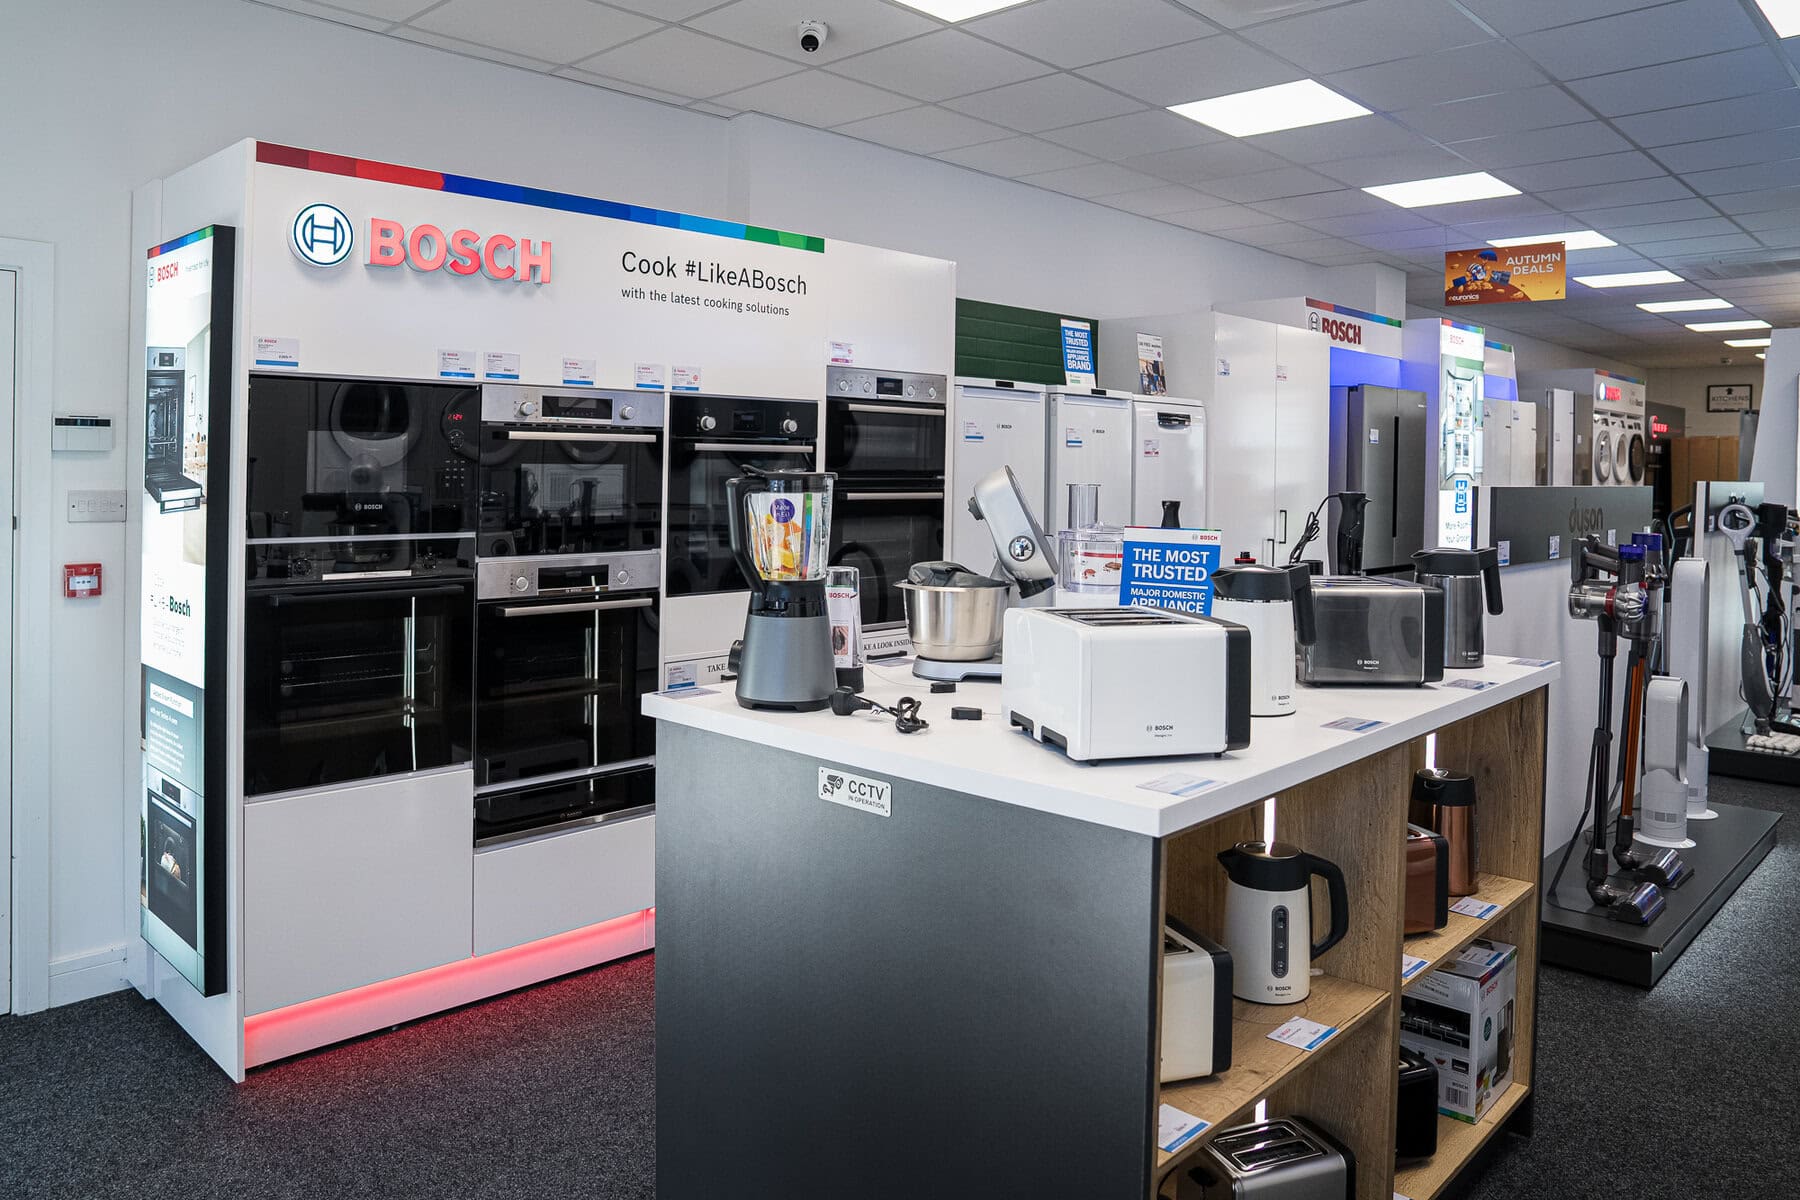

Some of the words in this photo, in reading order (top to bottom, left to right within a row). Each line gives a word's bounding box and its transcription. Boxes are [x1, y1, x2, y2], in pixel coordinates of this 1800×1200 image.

[367, 217, 552, 284] BOSCH
[1506, 253, 1561, 266] AUTUMN
[157, 261, 179, 282] BOSCH
[622, 251, 677, 278] Cook
[685, 259, 807, 295] #LikeABosch
[1513, 264, 1554, 275] DEALS
[621, 287, 645, 300] with
[649, 290, 667, 302] the
[671, 292, 700, 306] latest
[704, 298, 743, 313] cooking
[746, 302, 789, 316] solutions
[1067, 360, 1091, 370] BRAND
[1569, 496, 1603, 538] dyson
[1133, 548, 1161, 562] THE
[1165, 549, 1210, 565] MOST
[1132, 563, 1208, 582] TRUSTED
[1130, 587, 1160, 597] MAJOR
[1162, 590, 1206, 600] DOMESTIC
[169, 595, 191, 617] Bosch
[877, 641, 893, 649] LOOK
[707, 663, 726, 673] TAKE
[848, 780, 884, 800] CCTV
[854, 796, 885, 809] OPERATION
